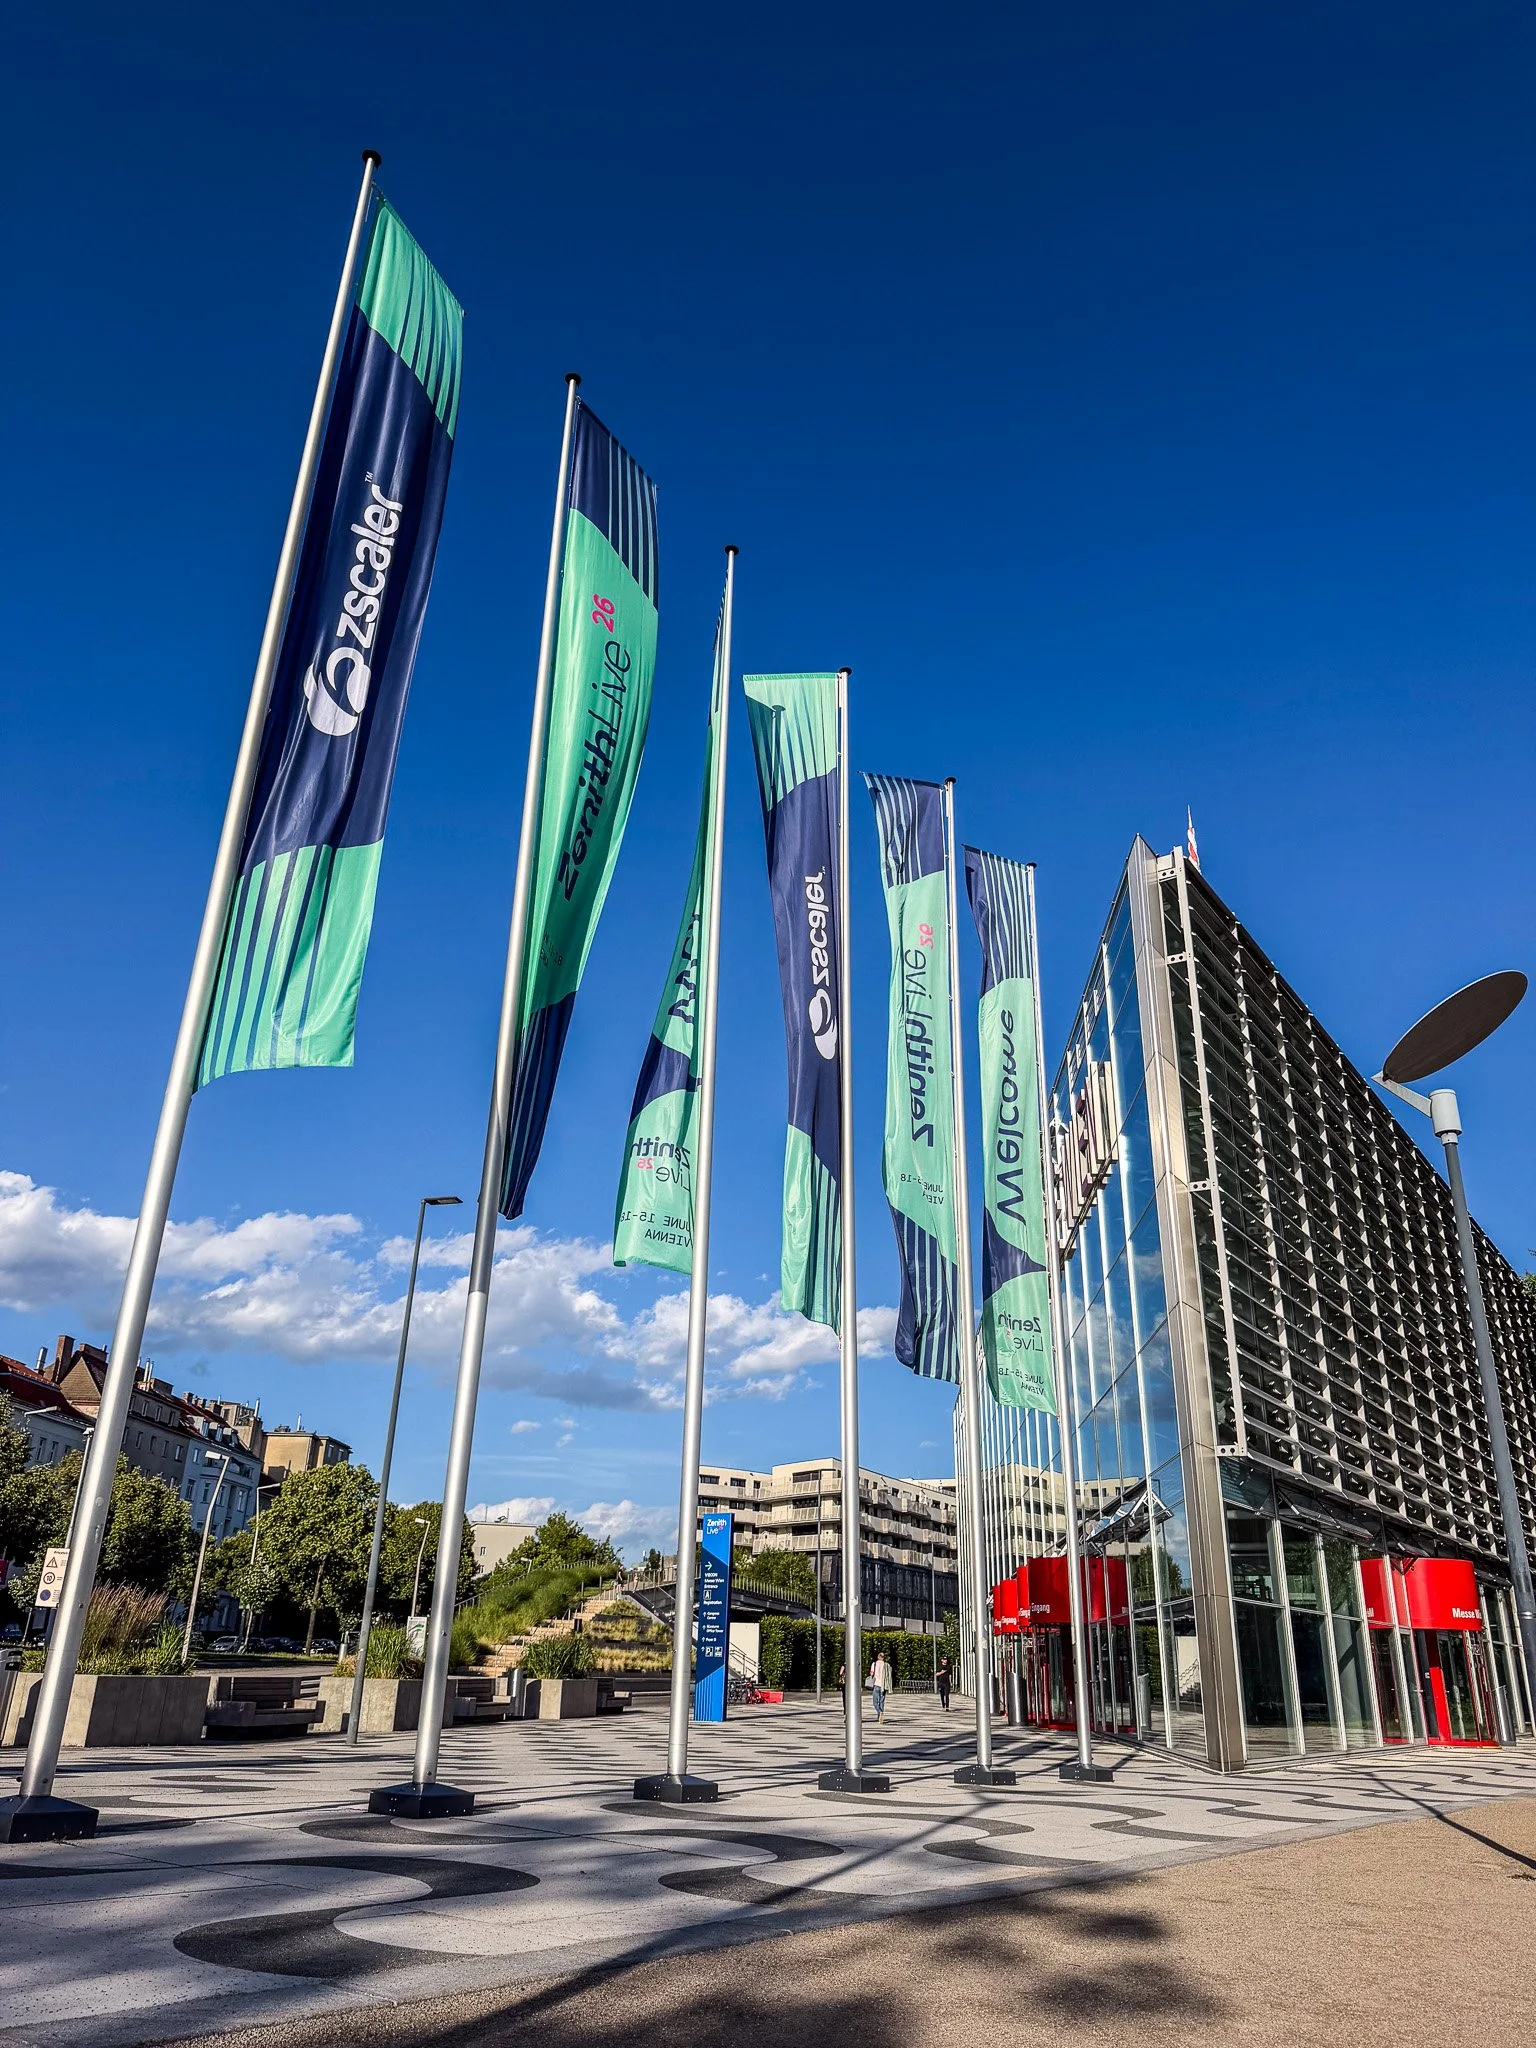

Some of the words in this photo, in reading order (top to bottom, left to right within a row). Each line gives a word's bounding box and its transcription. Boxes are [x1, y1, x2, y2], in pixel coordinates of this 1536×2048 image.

[336, 483, 403, 649] zscaler
[591, 593, 615, 633] 26
[707, 1519, 726, 1527] Zenith
